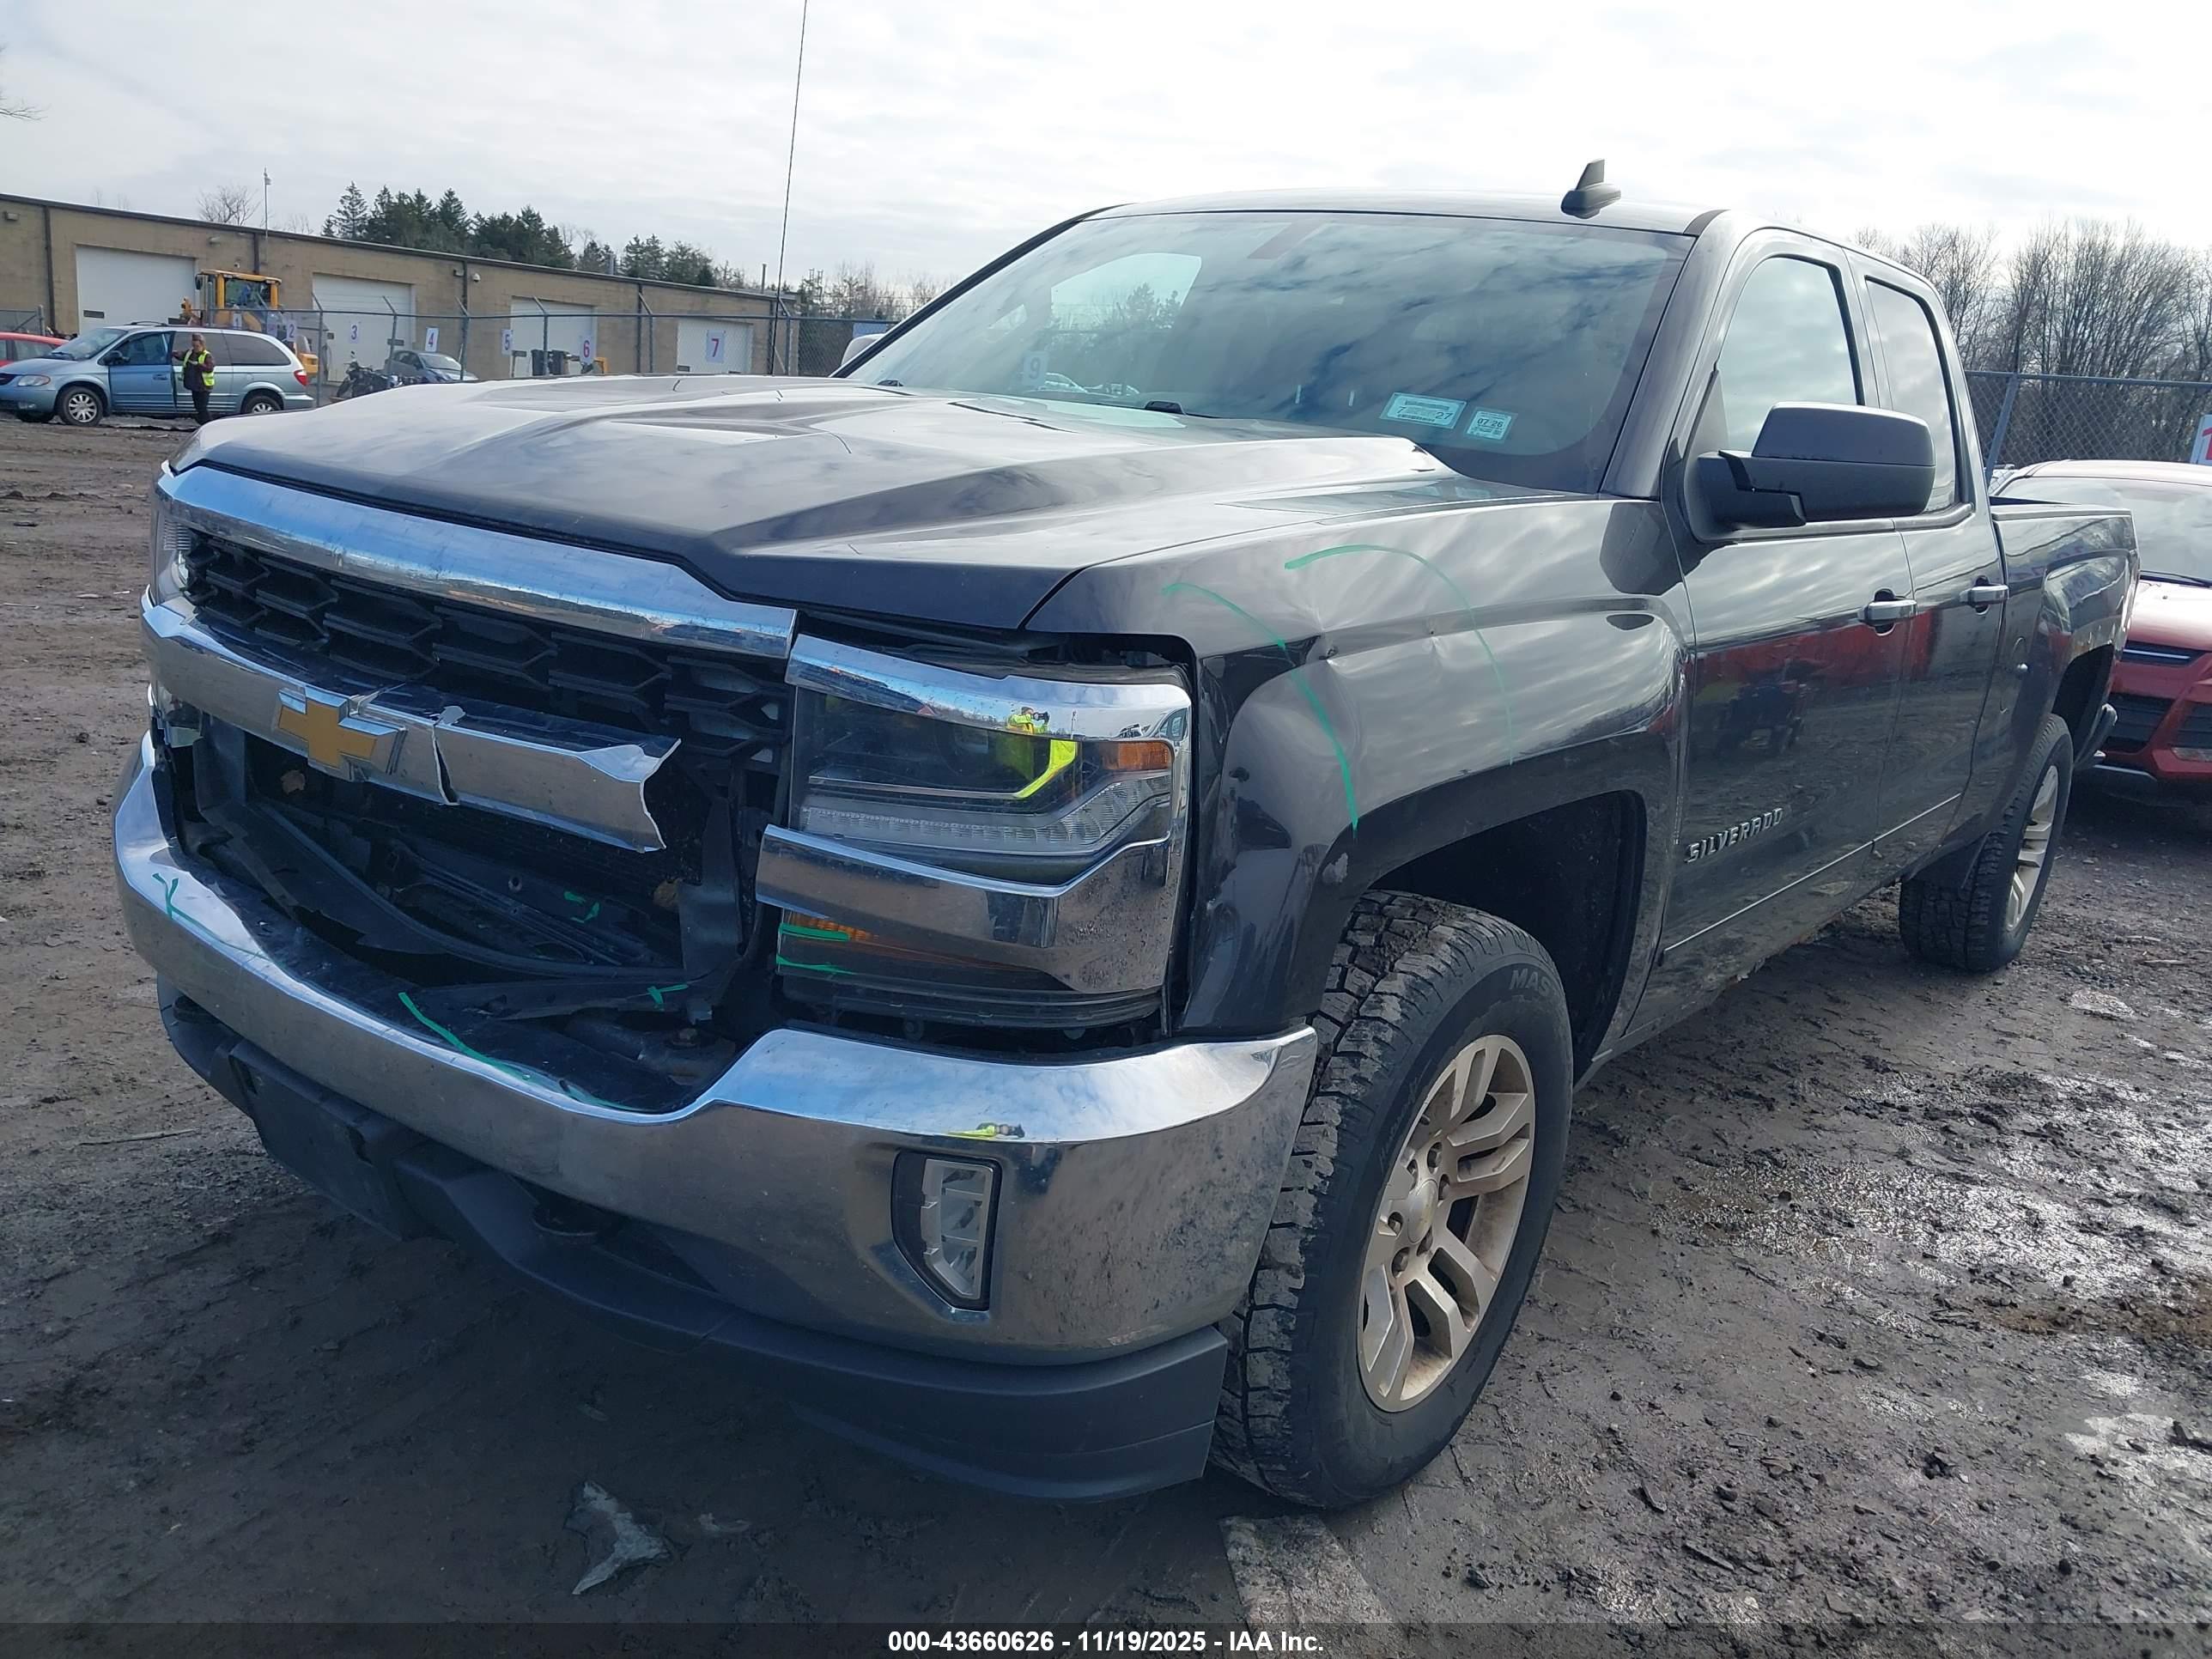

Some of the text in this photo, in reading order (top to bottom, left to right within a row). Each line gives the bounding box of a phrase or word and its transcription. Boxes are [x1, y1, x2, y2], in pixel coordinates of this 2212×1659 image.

[289, 324, 296, 339] 2
[350, 325, 359, 340] 3
[428, 332, 434, 348] 4
[504, 334, 511, 350] 5
[711, 338, 720, 358] 7
[583, 340, 591, 357] 6
[1029, 356, 1041, 380] 9
[1436, 411, 1454, 421] 27
[1685, 807, 1784, 863] SILVERADO
